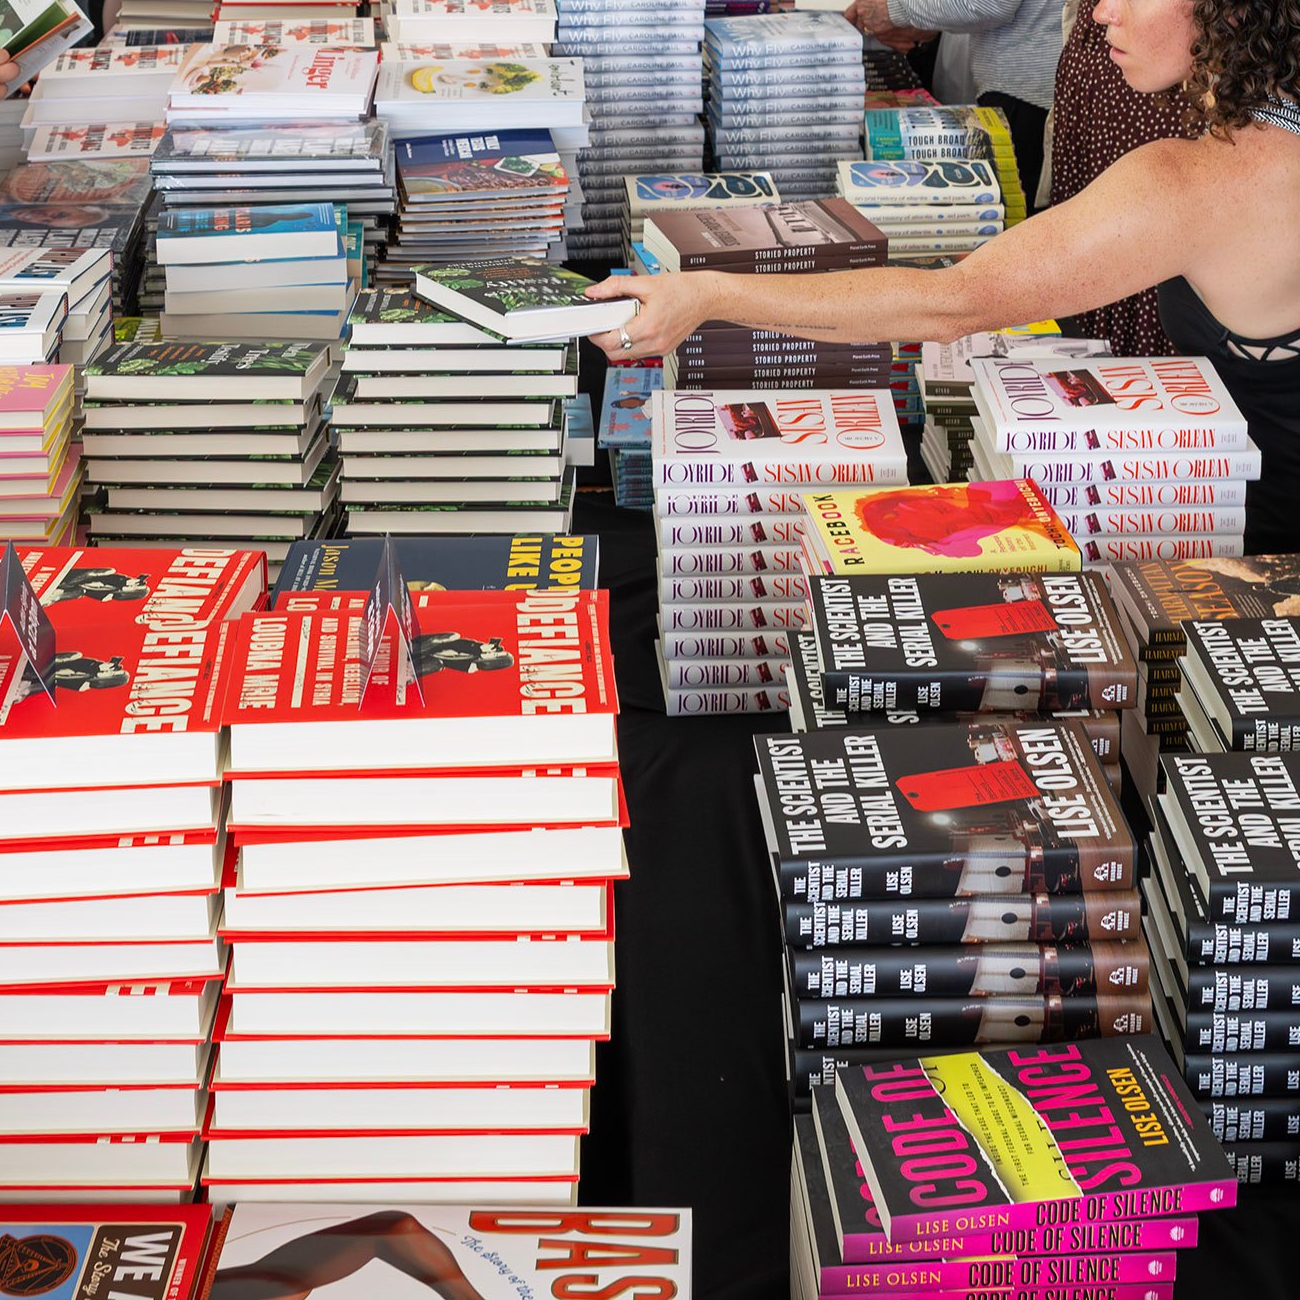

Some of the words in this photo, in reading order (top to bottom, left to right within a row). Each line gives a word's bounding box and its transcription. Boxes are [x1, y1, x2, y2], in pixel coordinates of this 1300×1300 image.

[732, 44, 762, 57] Why
[765, 44, 783, 56] Fly
[790, 43, 827, 51] CAROLINE
[829, 41, 848, 49] PAUL
[302, 49, 346, 89] Linger
[908, 135, 934, 147] TOUGH
[938, 134, 965, 146] BROAD
[911, 147, 938, 160] TOUGH
[690, 257, 706, 265] OTERO
[755, 250, 782, 260] STORIED
[783, 247, 816, 258] PROPERTY
[688, 359, 705, 367] OTERO
[755, 355, 782, 364] STORIED
[784, 353, 817, 364] PROPERTY
[674, 392, 722, 454] JOYRIDE
[776, 399, 829, 444] SUSAN
[830, 394, 886, 450] ORLEAN
[1005, 431, 1077, 452] JOYRIDE
[1106, 429, 1154, 450] SUSAN
[1157, 428, 1216, 449] ORLEAN
[662, 462, 735, 484] JOYRIDE
[764, 462, 812, 483] SUSAN
[816, 462, 874, 483] ORLEAN
[812, 494, 865, 566] RACEBOOK
[320, 545, 349, 577] Jason
[508, 536, 543, 580] LIKE
[246, 617, 288, 672] LOUBNA
[317, 634, 337, 672] SURVIVAL
[516, 600, 587, 715] DEFIANCE
[120, 619, 211, 734] DEFIANCE
[238, 675, 280, 710] MRIE
[312, 682, 333, 706] SYRIA
[767, 738, 819, 816] SCIENTIST
[811, 758, 849, 789] THE
[844, 735, 890, 789] KILLER
[1017, 729, 1078, 790] OLSEN
[820, 792, 861, 825] AND
[1174, 757, 1239, 838] SCIENTIST
[1220, 777, 1262, 809] THE
[859, 792, 908, 849] SERIAL
[1044, 794, 1100, 839] LISE
[1238, 813, 1283, 848] AND
[783, 818, 827, 854] THE
[821, 865, 834, 883] THE
[1212, 841, 1254, 876] THE
[794, 877, 806, 894] THE
[808, 861, 821, 902] SCIENTIST
[821, 884, 834, 900] AND
[835, 868, 849, 898] SERIAL
[850, 867, 862, 897] KILLER
[886, 871, 899, 892] LISE
[900, 866, 912, 895] OLSEN
[861, 1055, 930, 1103] OF
[1106, 1067, 1151, 1113] OLSEN
[1007, 1043, 1142, 1190] SILENCE
[1132, 1117, 1169, 1147] LISE
[881, 1108, 988, 1207] CODE
[916, 1220, 952, 1235] LISE
[956, 1213, 1010, 1231] OLSEN
[1036, 1200, 1081, 1226] CODE
[1086, 1196, 1109, 1220] OF
[1111, 1187, 1184, 1218] SILENCE
[123, 1230, 177, 1283] WE
